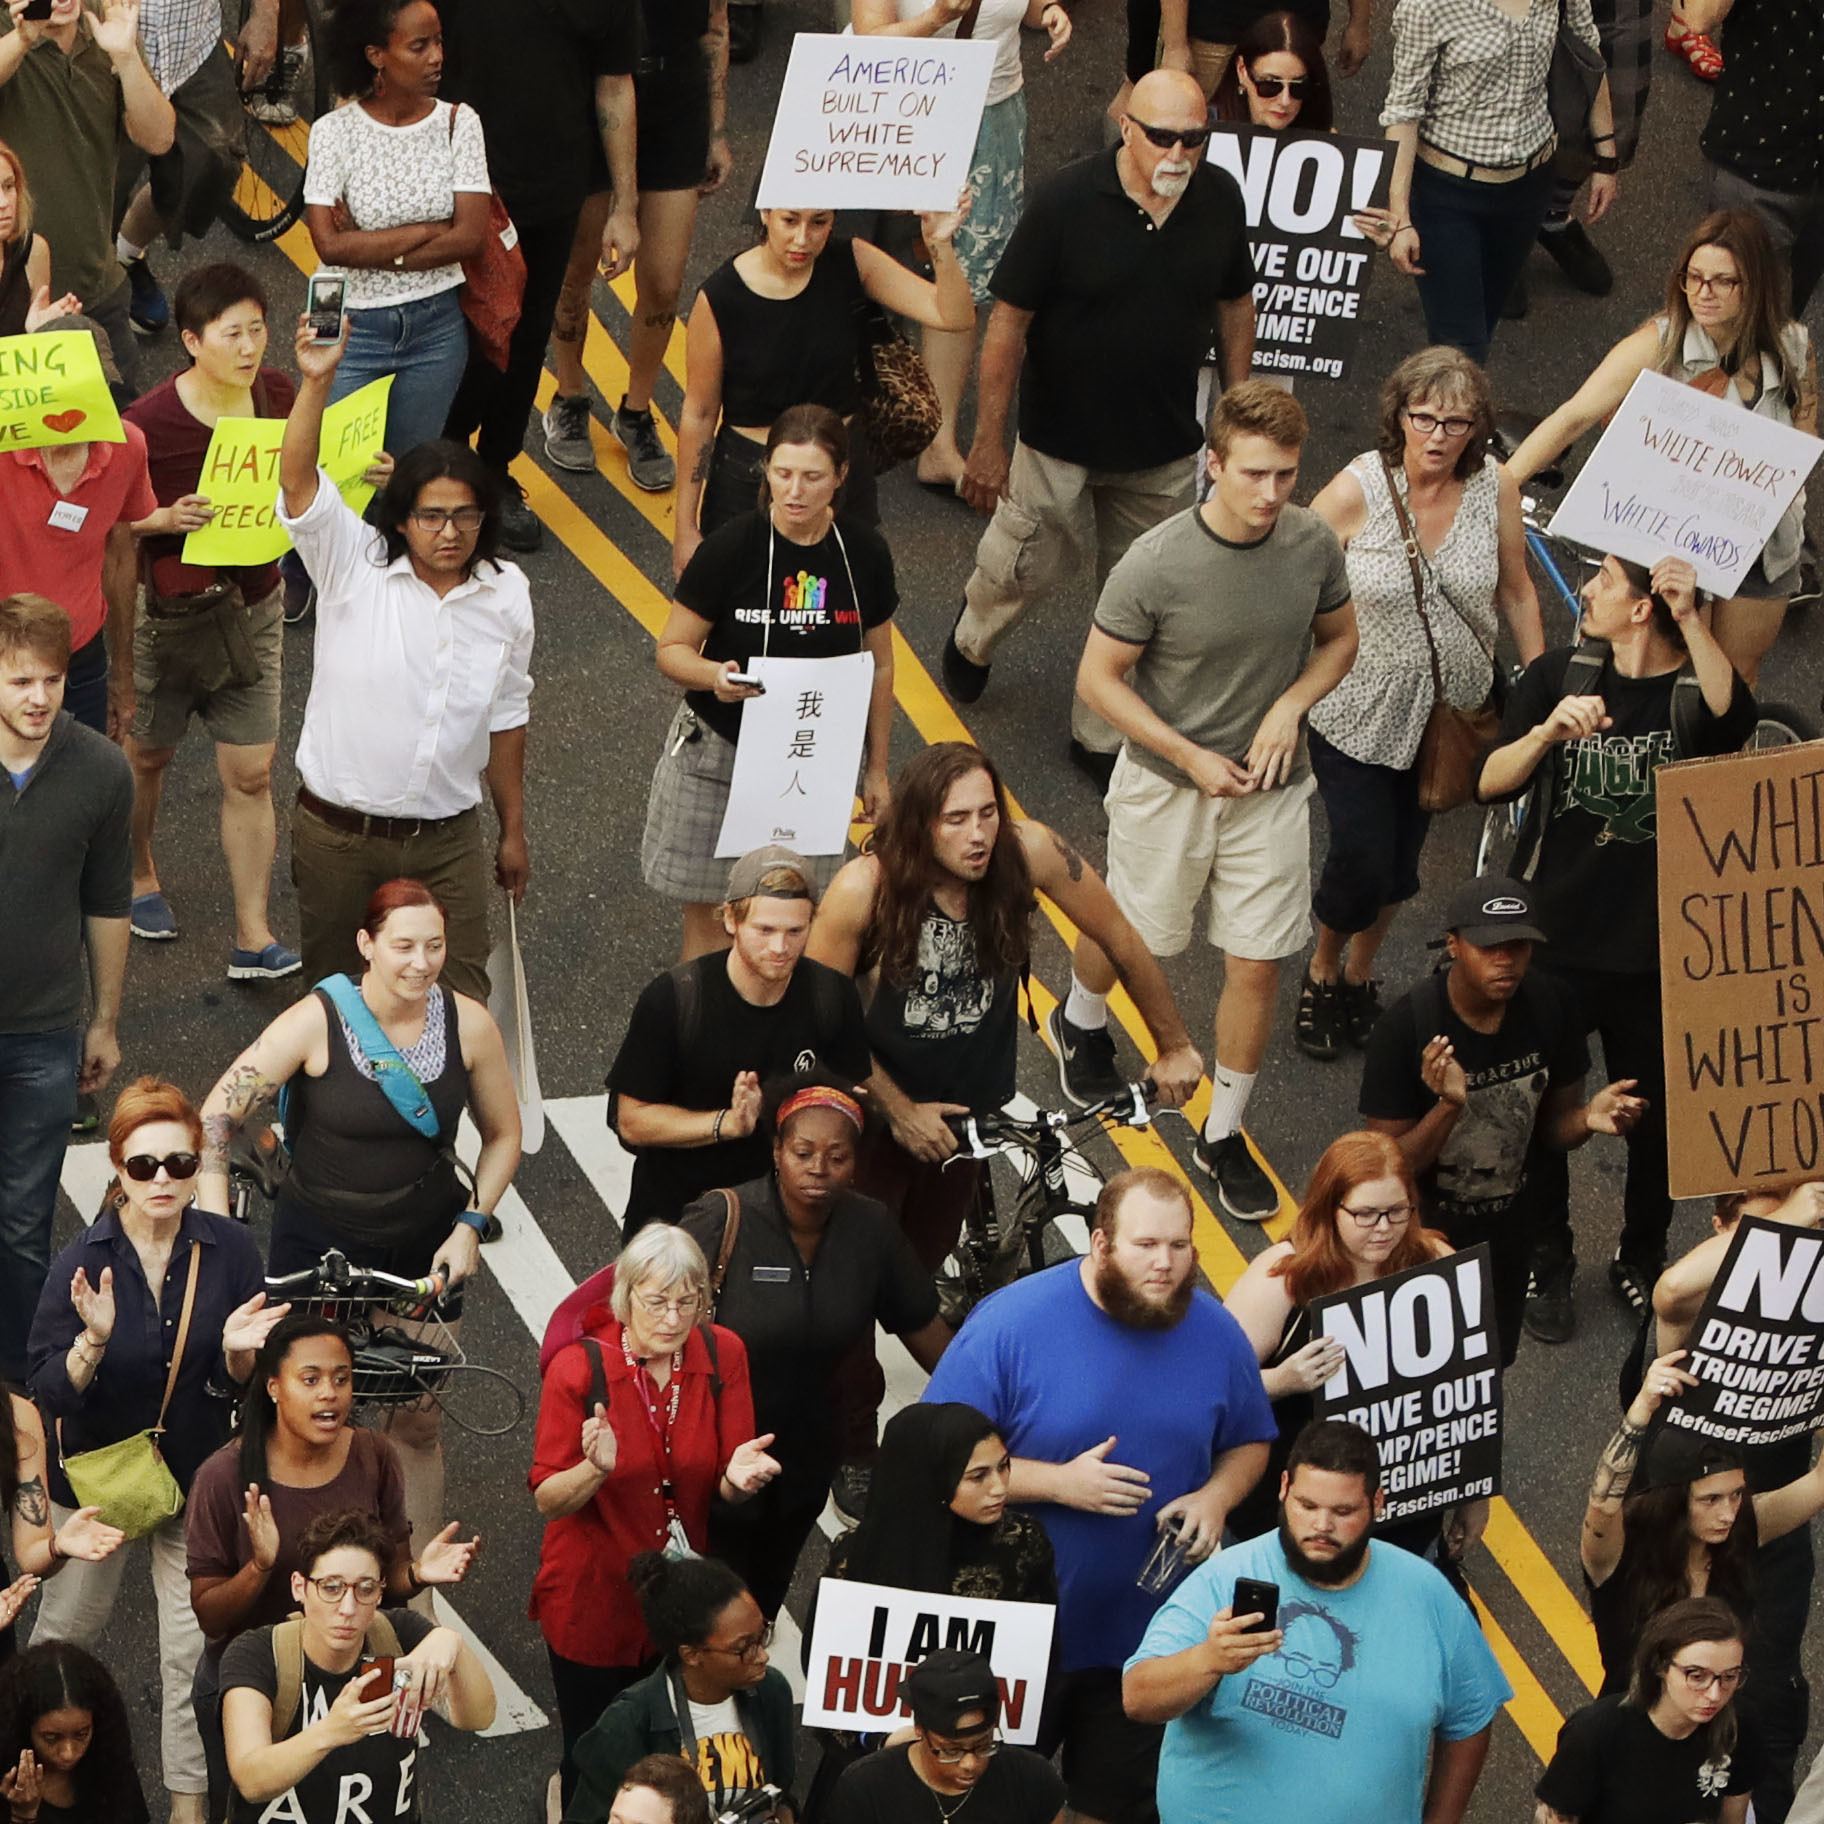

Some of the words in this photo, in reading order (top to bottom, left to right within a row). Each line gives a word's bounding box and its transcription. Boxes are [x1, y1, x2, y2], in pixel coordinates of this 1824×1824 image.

[829, 54, 955, 88] AMERICA:
[822, 90, 890, 118] BUILT
[898, 91, 936, 118] ON
[828, 121, 915, 146] WHITE
[794, 152, 946, 179] SUPREMACY
[1207, 134, 1382, 240] NO!
[1295, 250, 1368, 287] OUT
[4, 384, 60, 409] SIDE
[337, 406, 380, 460] FREE
[735, 609, 775, 625] RISE.
[779, 607, 831, 625] UNITE.
[777, 688, 825, 799] 我是人
[1776, 972, 1809, 1018] IS
[1685, 1018, 1824, 1092] WHIT
[1322, 1257, 1489, 1401] NO!
[1698, 1318, 1817, 1366] DRIVE
[1430, 1368, 1496, 1417] OUT
[1712, 1388, 1820, 1421] REGIME!
[867, 1604, 891, 1659] I
[904, 1611, 997, 1666] AM
[1244, 1697, 1342, 1738] REVOLUTION
[1248, 1683, 1345, 1723] POLITICAL
